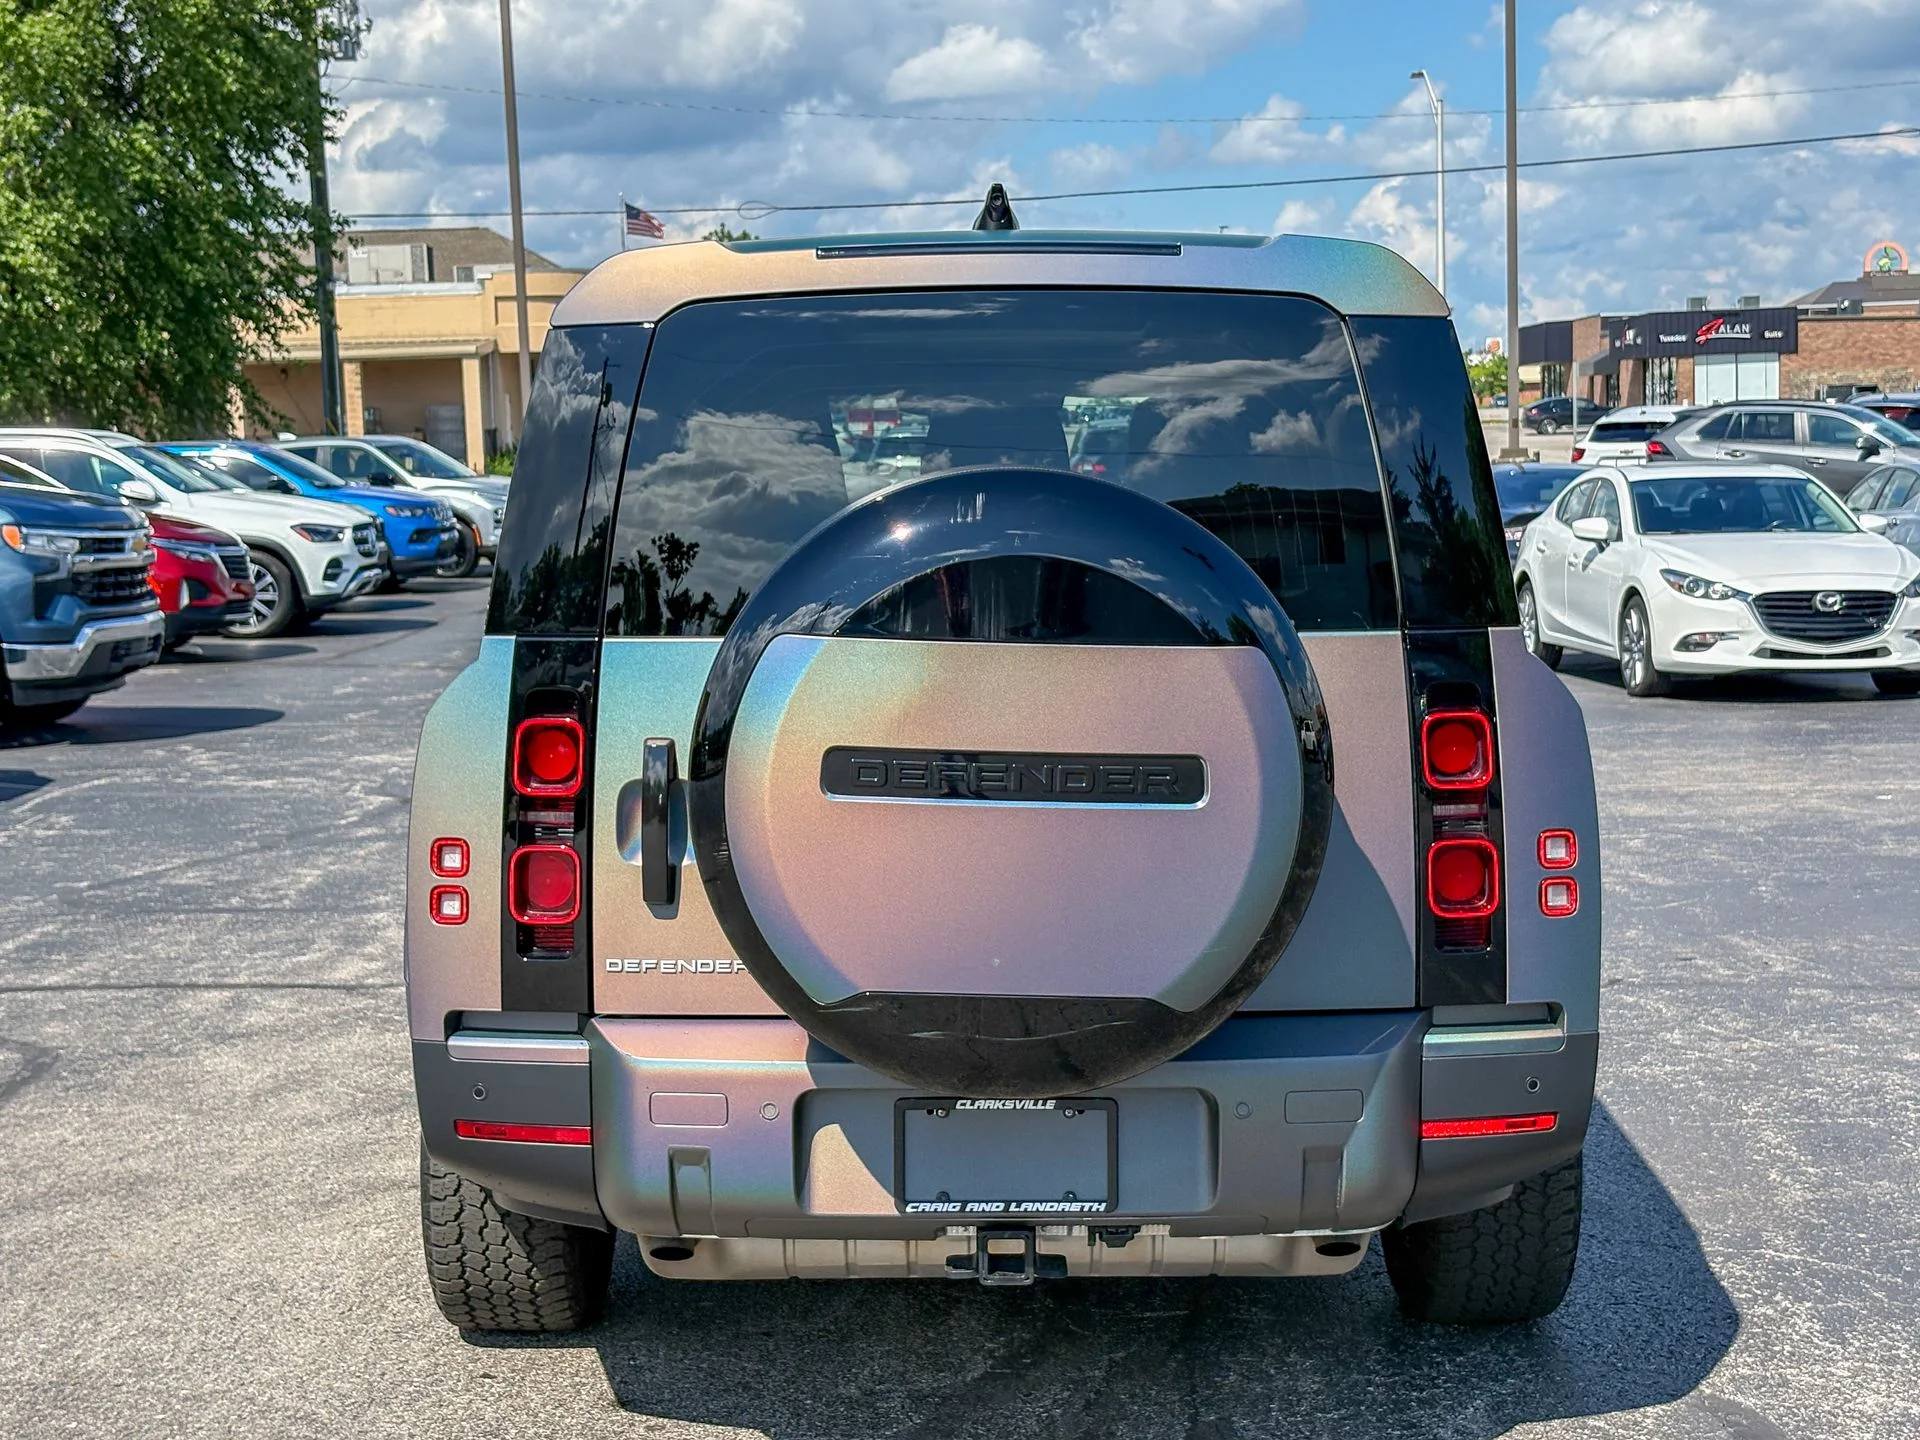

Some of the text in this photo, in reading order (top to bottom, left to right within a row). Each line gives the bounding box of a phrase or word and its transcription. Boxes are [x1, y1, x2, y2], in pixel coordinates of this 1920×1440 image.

[851, 758, 1180, 795] DEFENDER
[955, 1099, 1057, 1110] CLARKSVILLE
[905, 1202, 1107, 1213] CRAIG AND LANDRETH
